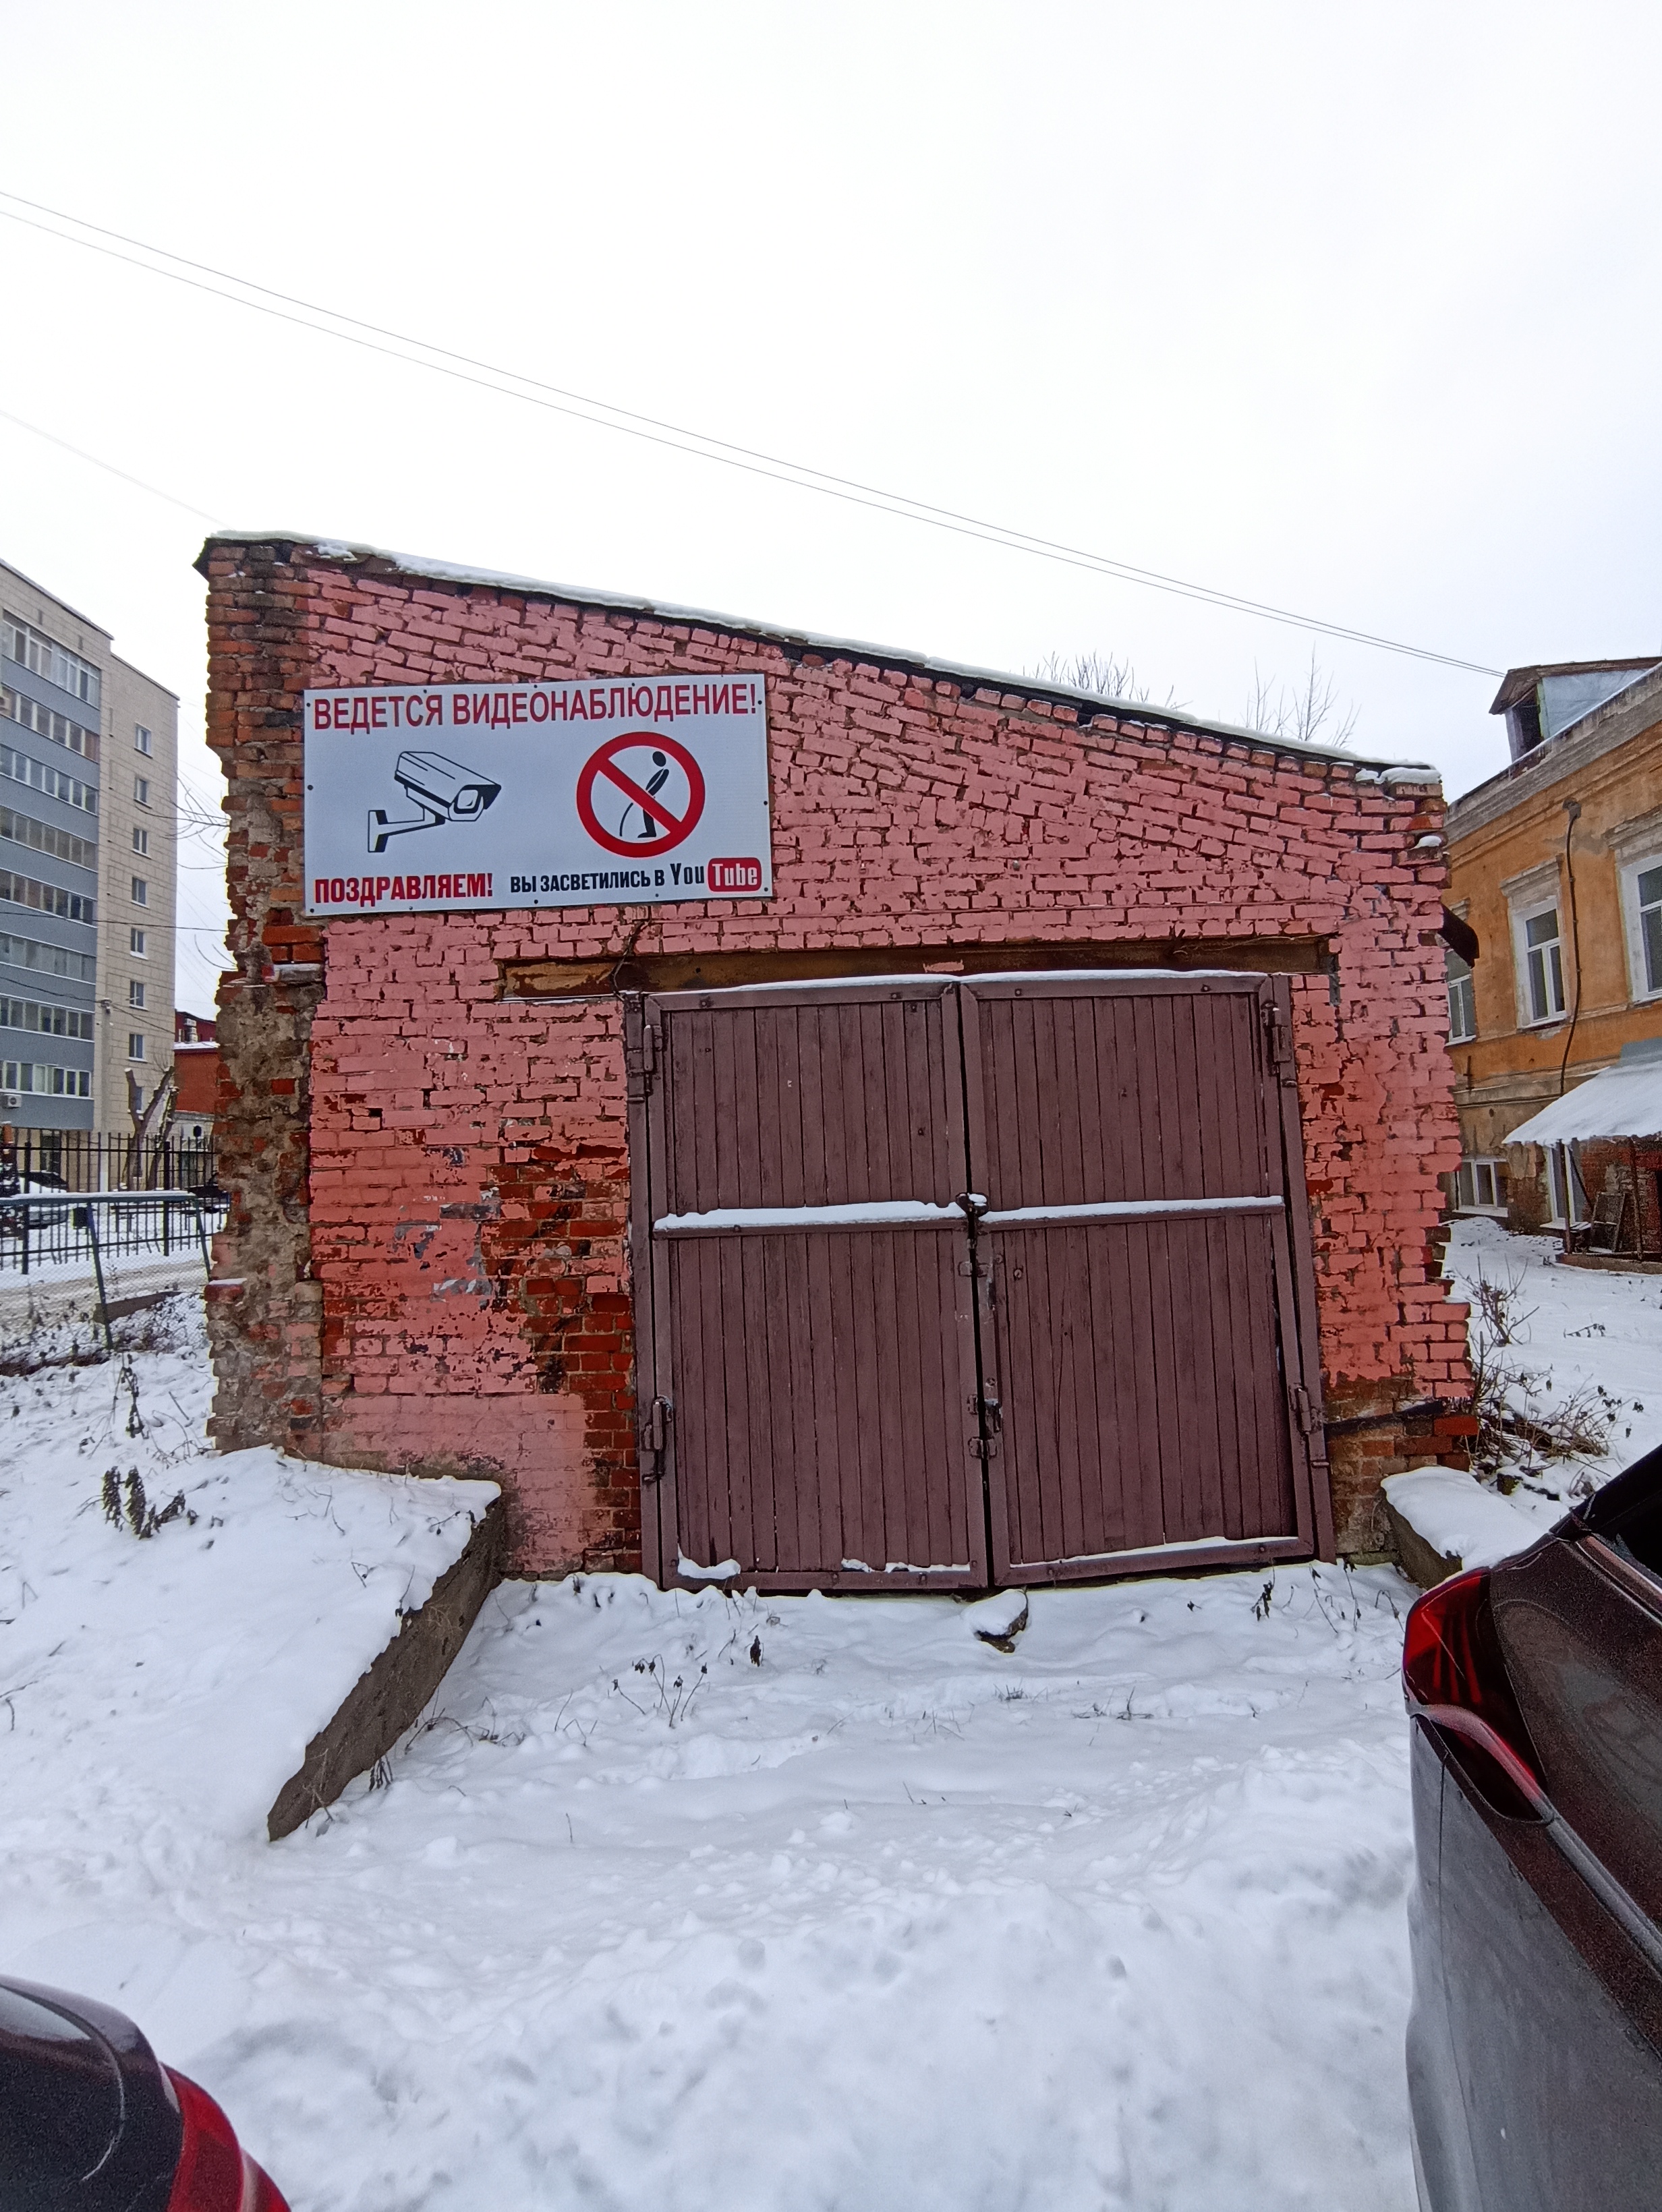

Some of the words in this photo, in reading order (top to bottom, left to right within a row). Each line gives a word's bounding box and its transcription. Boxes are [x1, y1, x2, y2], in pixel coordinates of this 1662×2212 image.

[314, 694, 443, 734] ВЕДЕТСЯ
[453, 683, 757, 730] ВИДЕОНАБЛЮДЕНИЕ!
[314, 873, 493, 907] ПОЗДРАВЛЯЕМ!
[510, 875, 537, 894] ВЫ
[540, 871, 651, 892] ЗАСВЕТИЛИСЬ
[654, 869, 665, 887] В
